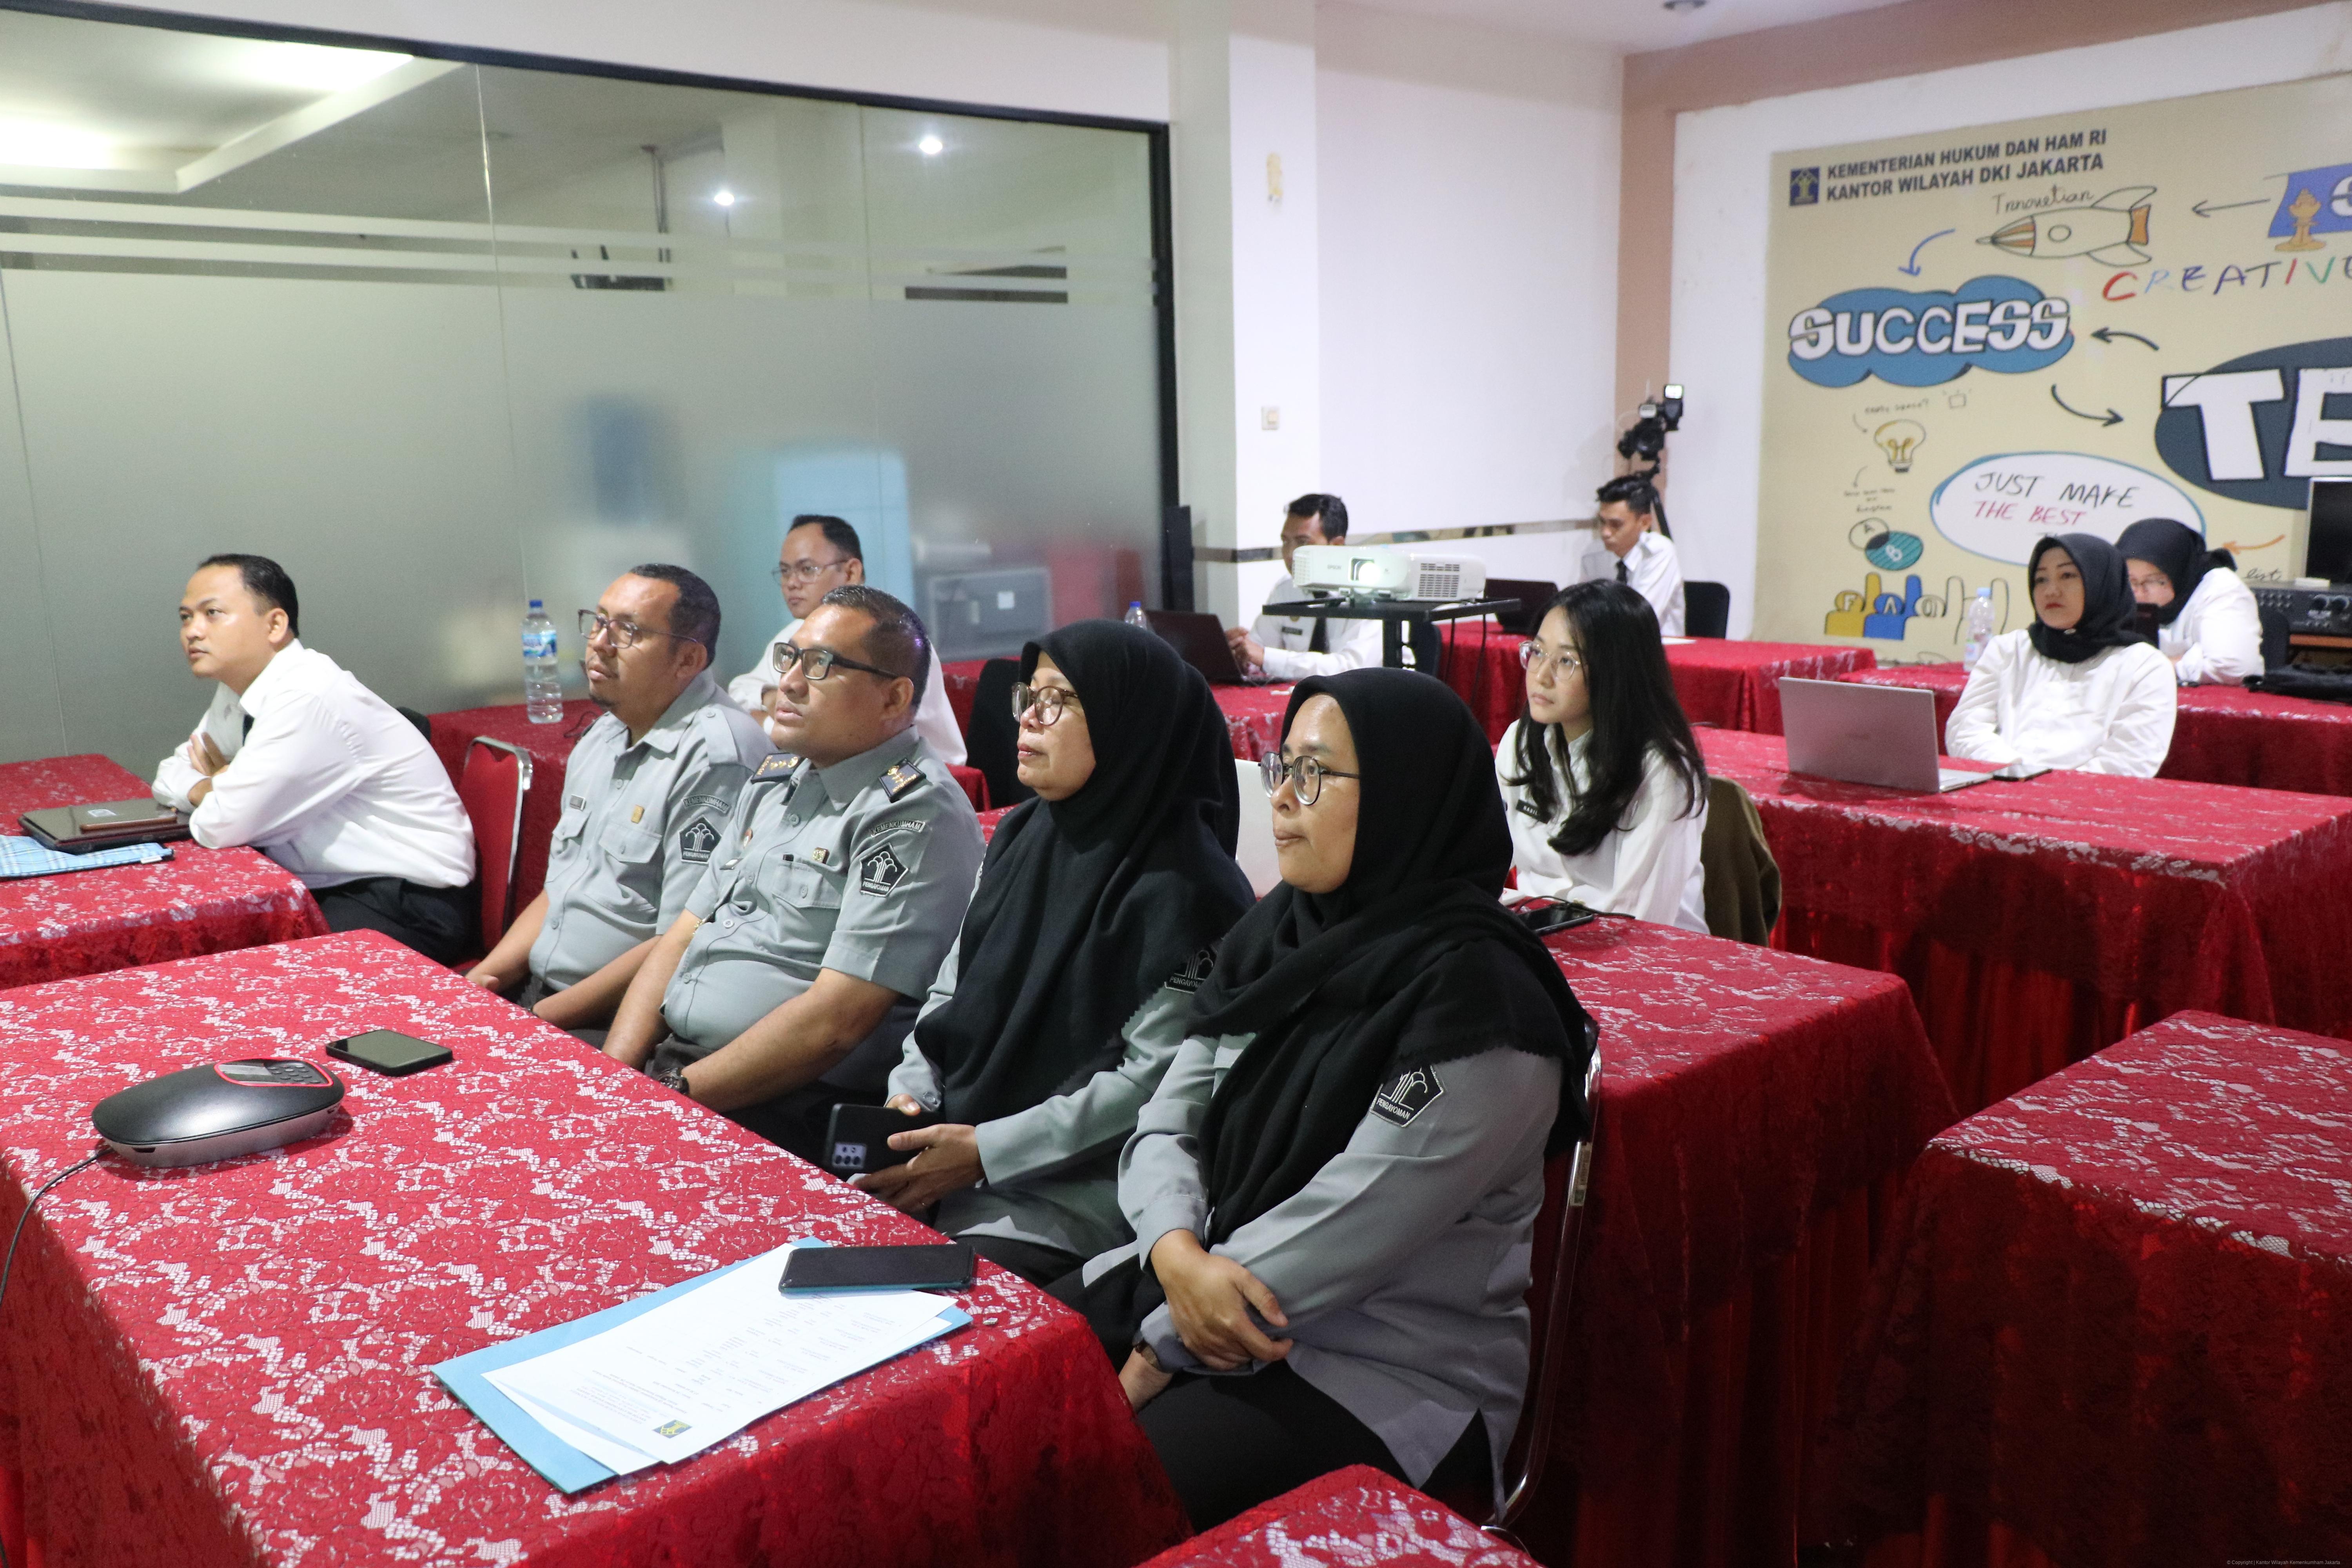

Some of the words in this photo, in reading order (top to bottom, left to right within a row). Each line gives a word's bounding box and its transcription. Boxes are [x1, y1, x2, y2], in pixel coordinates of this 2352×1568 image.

[1828, 151, 1935, 179] KEMENTERIAN
[1940, 143, 2000, 165] HUKUM
[2005, 137, 2039, 156] DAN
[2045, 131, 2083, 151] HAM
[2089, 128, 2107, 146] RI
[1827, 179, 1893, 201] KANTOR
[1898, 169, 1974, 193] WILAYAH
[1980, 163, 2011, 183] DKI
[2016, 153, 2103, 179] JAKARTA
[1788, 297, 2071, 361] SUCCESS
[1975, 472, 2045, 498] JUST
[2059, 482, 2140, 509] MAKE
[1975, 500, 2019, 520] THE
[2029, 505, 2087, 526] BEST
[872, 820, 921, 834] KEMENKUMHAM
[862, 881, 889, 892] PENGAYOMAN
[1376, 1098, 1410, 1120] PENGAYOMAN
